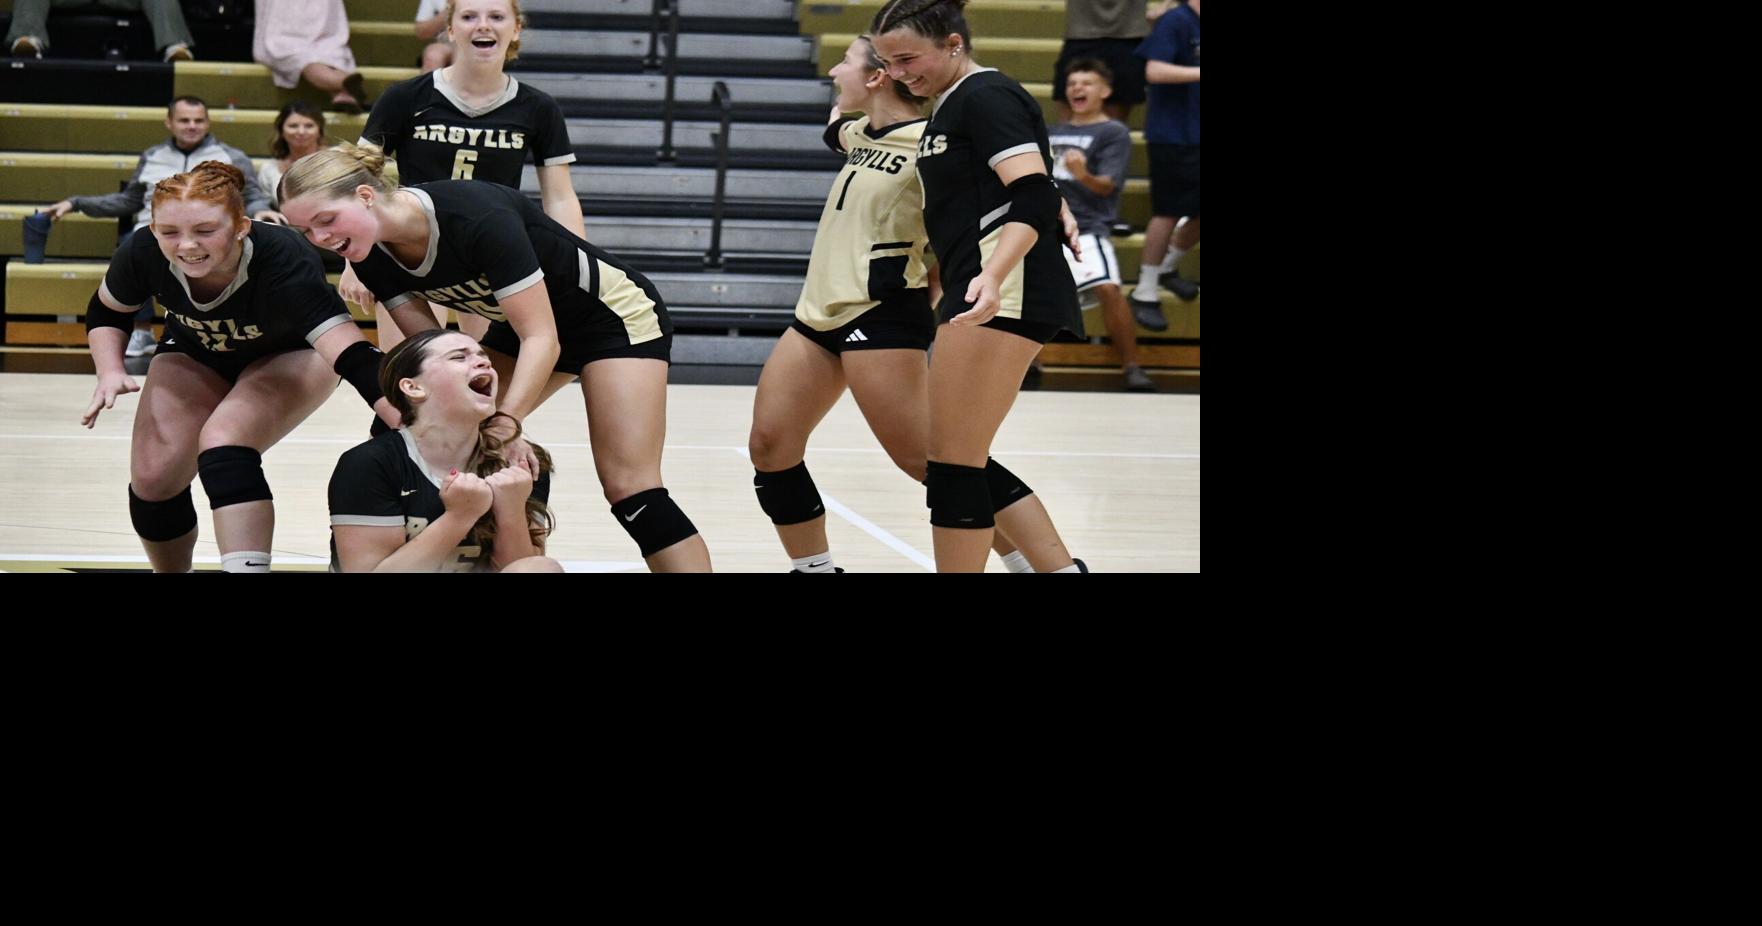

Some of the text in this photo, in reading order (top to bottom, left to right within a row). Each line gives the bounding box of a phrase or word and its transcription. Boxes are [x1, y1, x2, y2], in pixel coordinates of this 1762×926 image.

[413, 124, 525, 149] ARGYLLS
[451, 149, 479, 180] 6
[836, 170, 857, 211] 1
[410, 273, 493, 303] RGYLL
[174, 313, 264, 341] GYLLS
